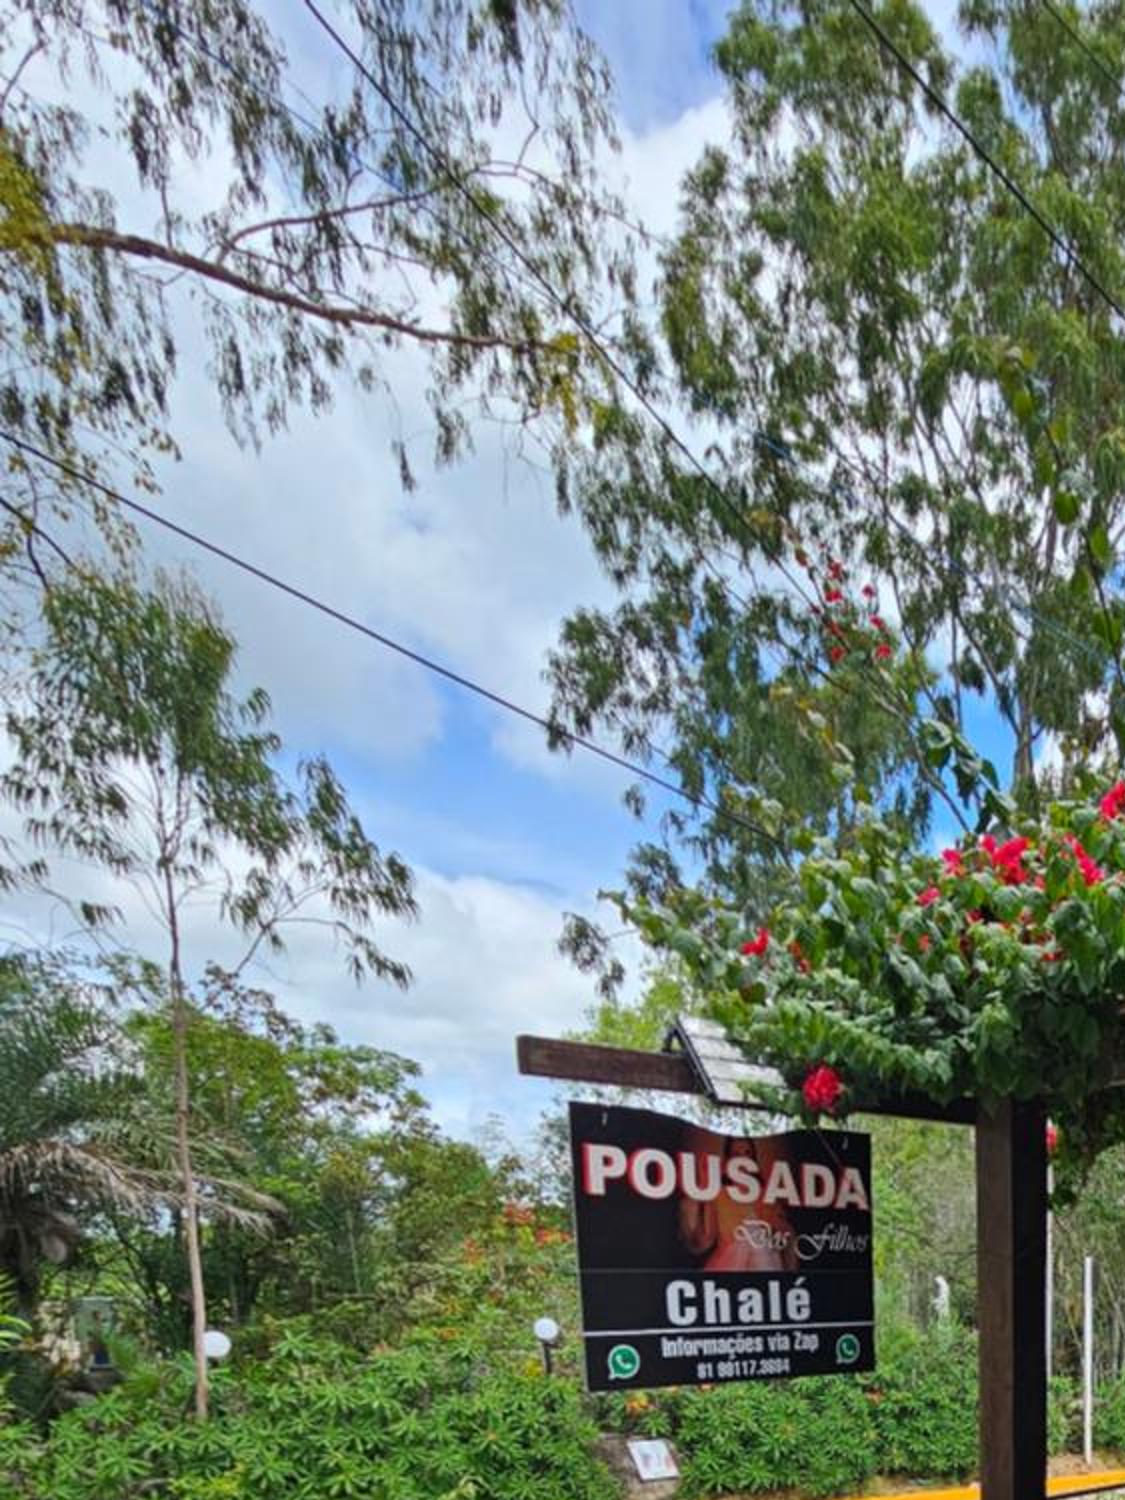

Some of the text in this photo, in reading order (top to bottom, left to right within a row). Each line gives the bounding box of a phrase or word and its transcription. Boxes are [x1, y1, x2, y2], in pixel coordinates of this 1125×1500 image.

[582, 1142, 868, 1211] POUSADA
[793, 1222, 869, 1260] Filhos
[666, 1276, 811, 1326] Chalé
[661, 1331, 820, 1360] Informações via Zap
